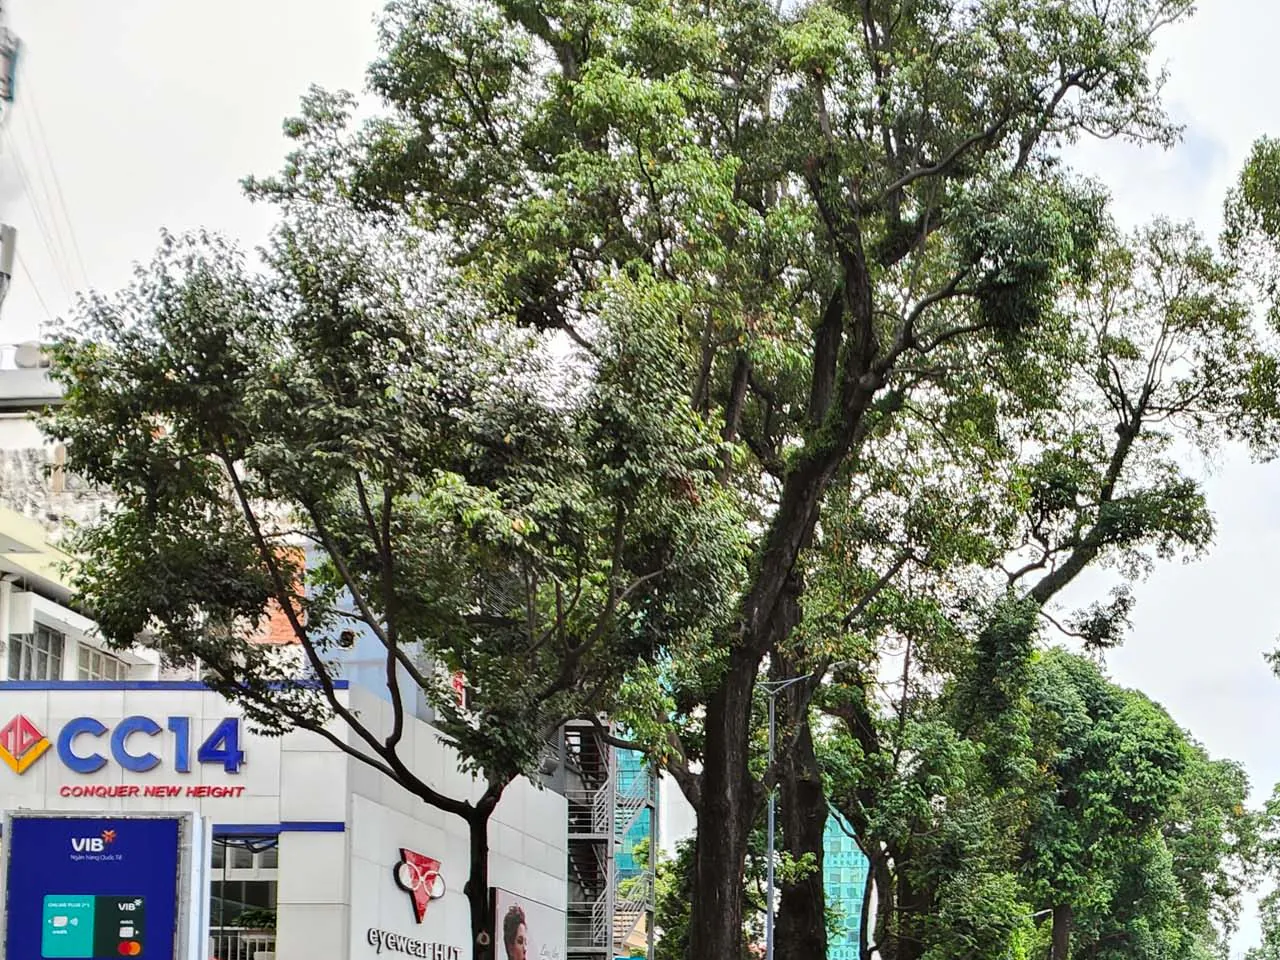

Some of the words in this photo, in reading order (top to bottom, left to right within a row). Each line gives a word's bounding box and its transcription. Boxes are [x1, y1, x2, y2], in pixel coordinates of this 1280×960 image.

[57, 715, 246, 774] CC14
[59, 785, 140, 798] CONQUER
[143, 785, 182, 798] NEW
[185, 785, 246, 799] HEIGHT
[71, 838, 104, 852] VIB
[118, 902, 136, 911] VIB
[367, 927, 430, 959] eyewear
